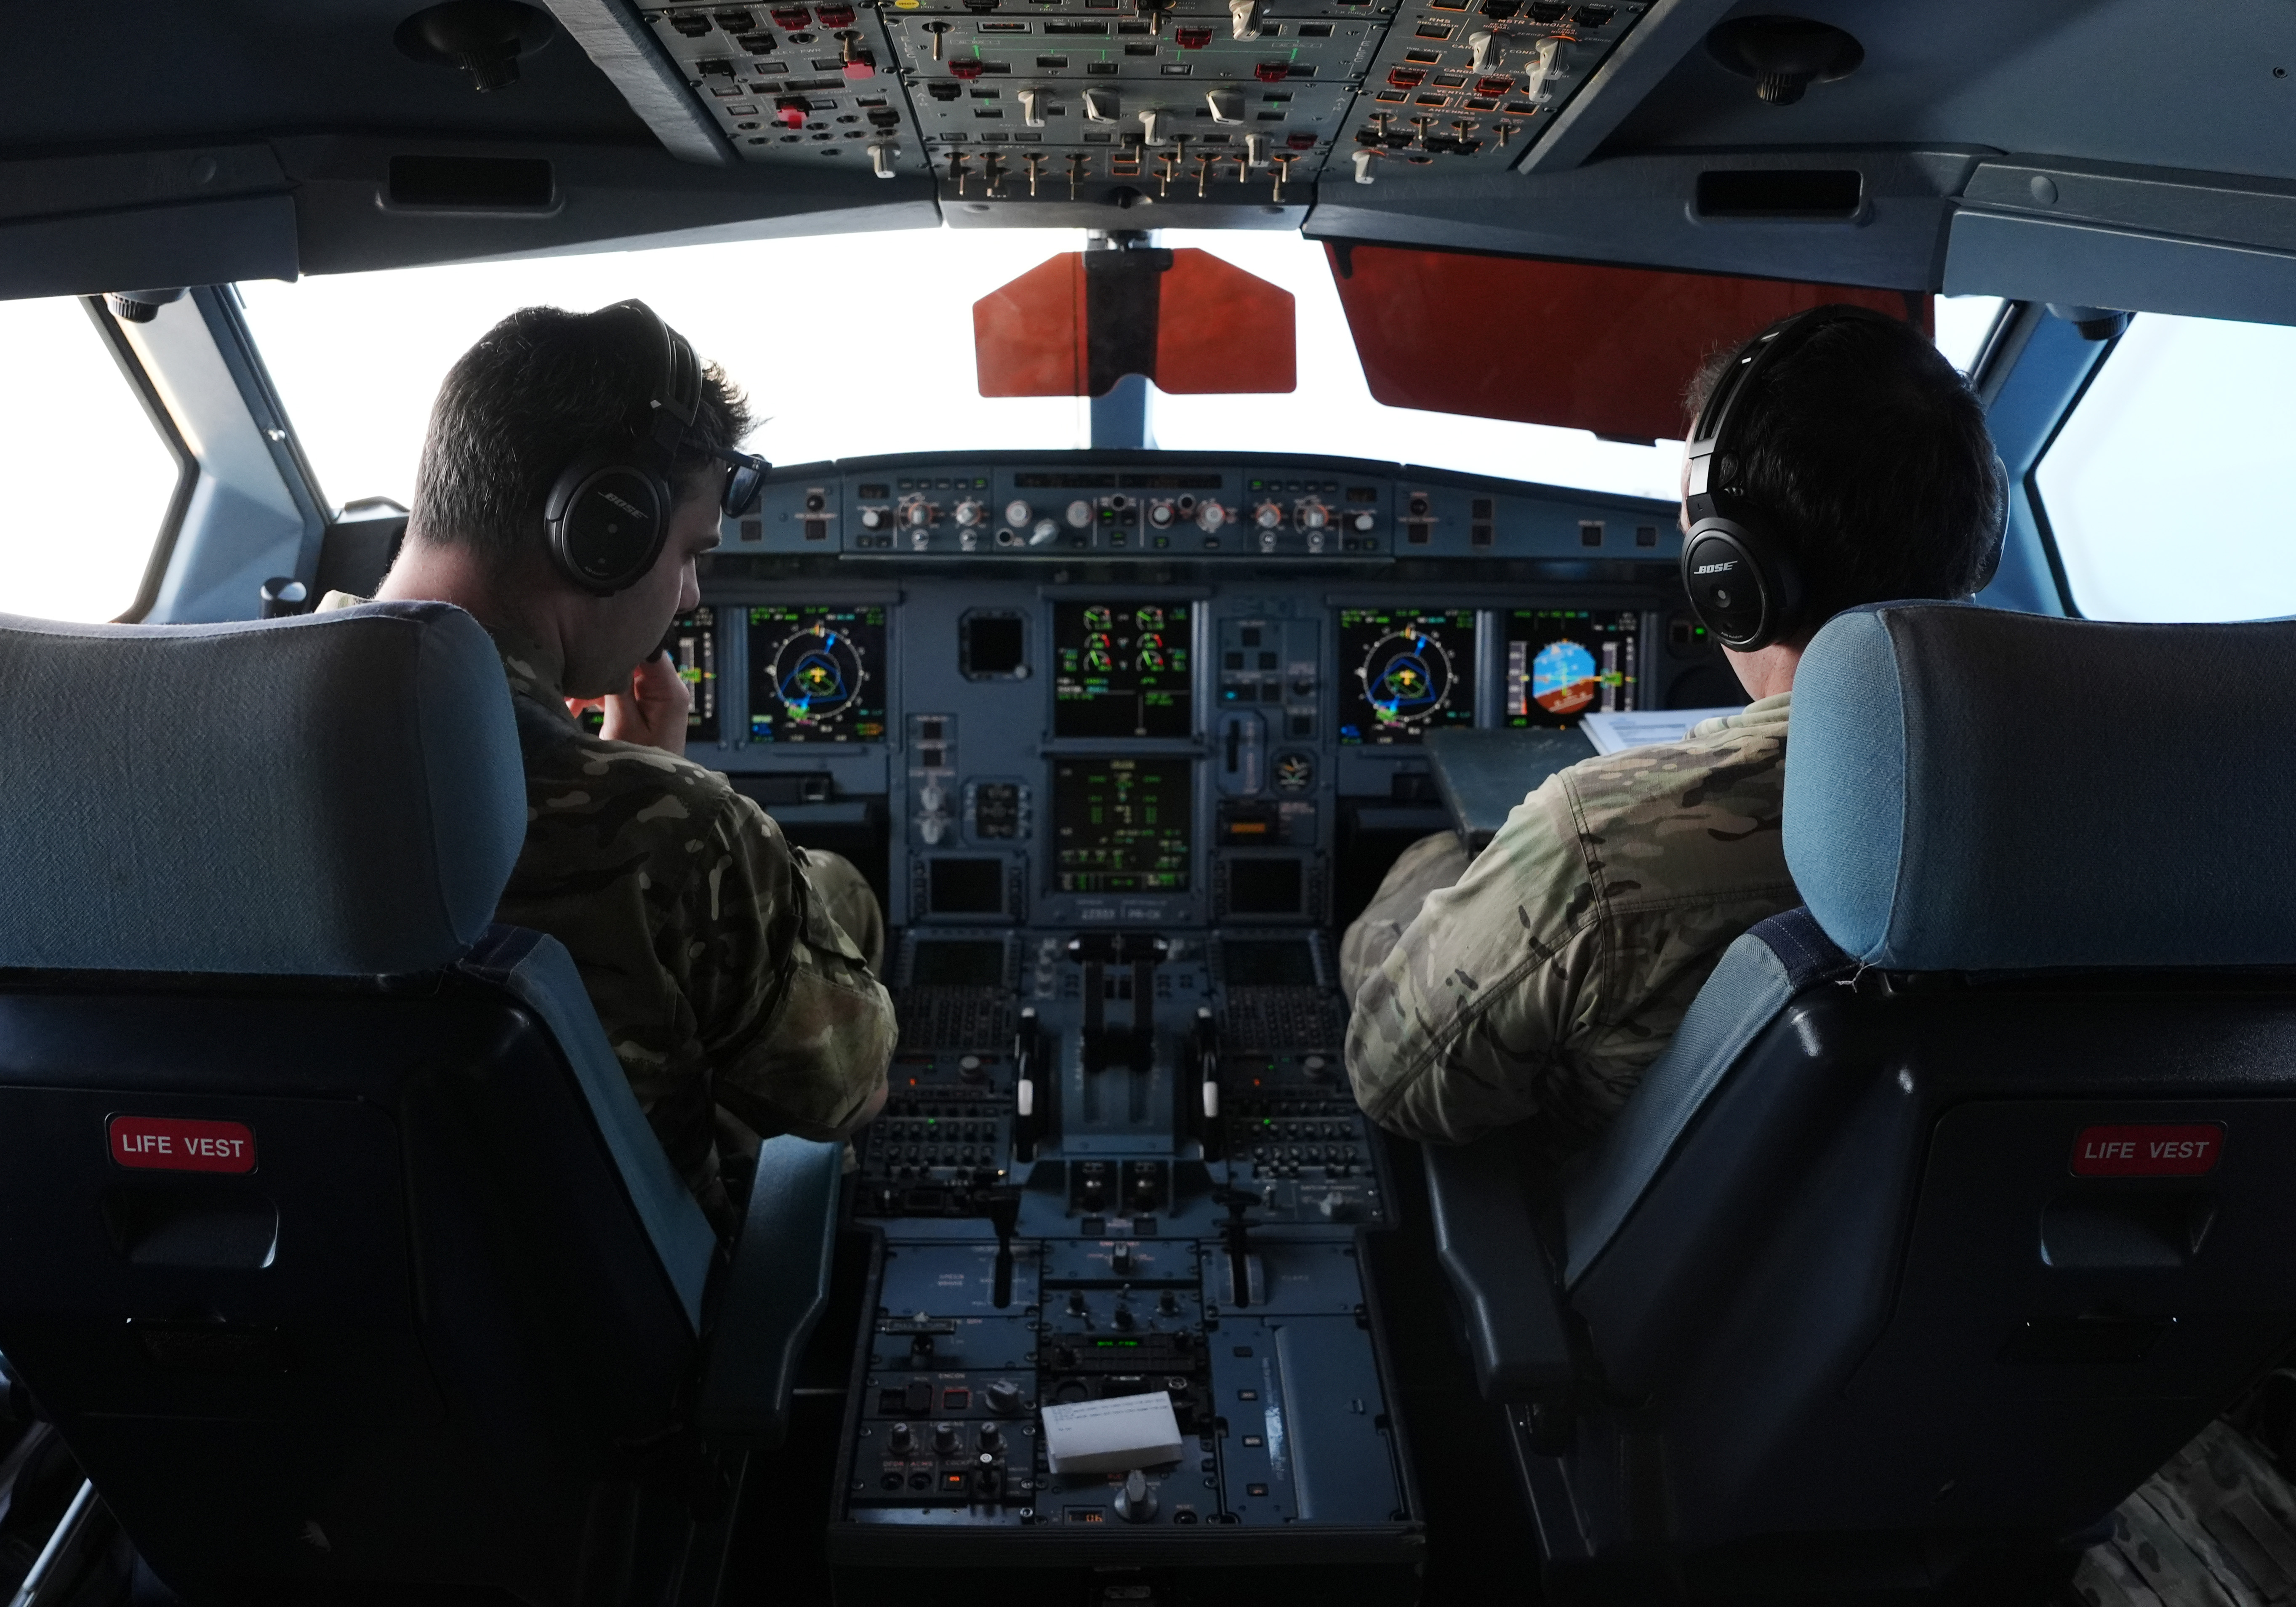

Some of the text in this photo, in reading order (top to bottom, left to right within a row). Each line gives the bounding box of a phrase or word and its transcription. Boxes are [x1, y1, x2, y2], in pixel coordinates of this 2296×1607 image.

[597, 491, 649, 519] BOSE
[1693, 560, 1738, 575] BOSE
[123, 1134, 244, 1158] LIFE VEST
[2084, 1141, 2210, 1159] LIFE VEST
